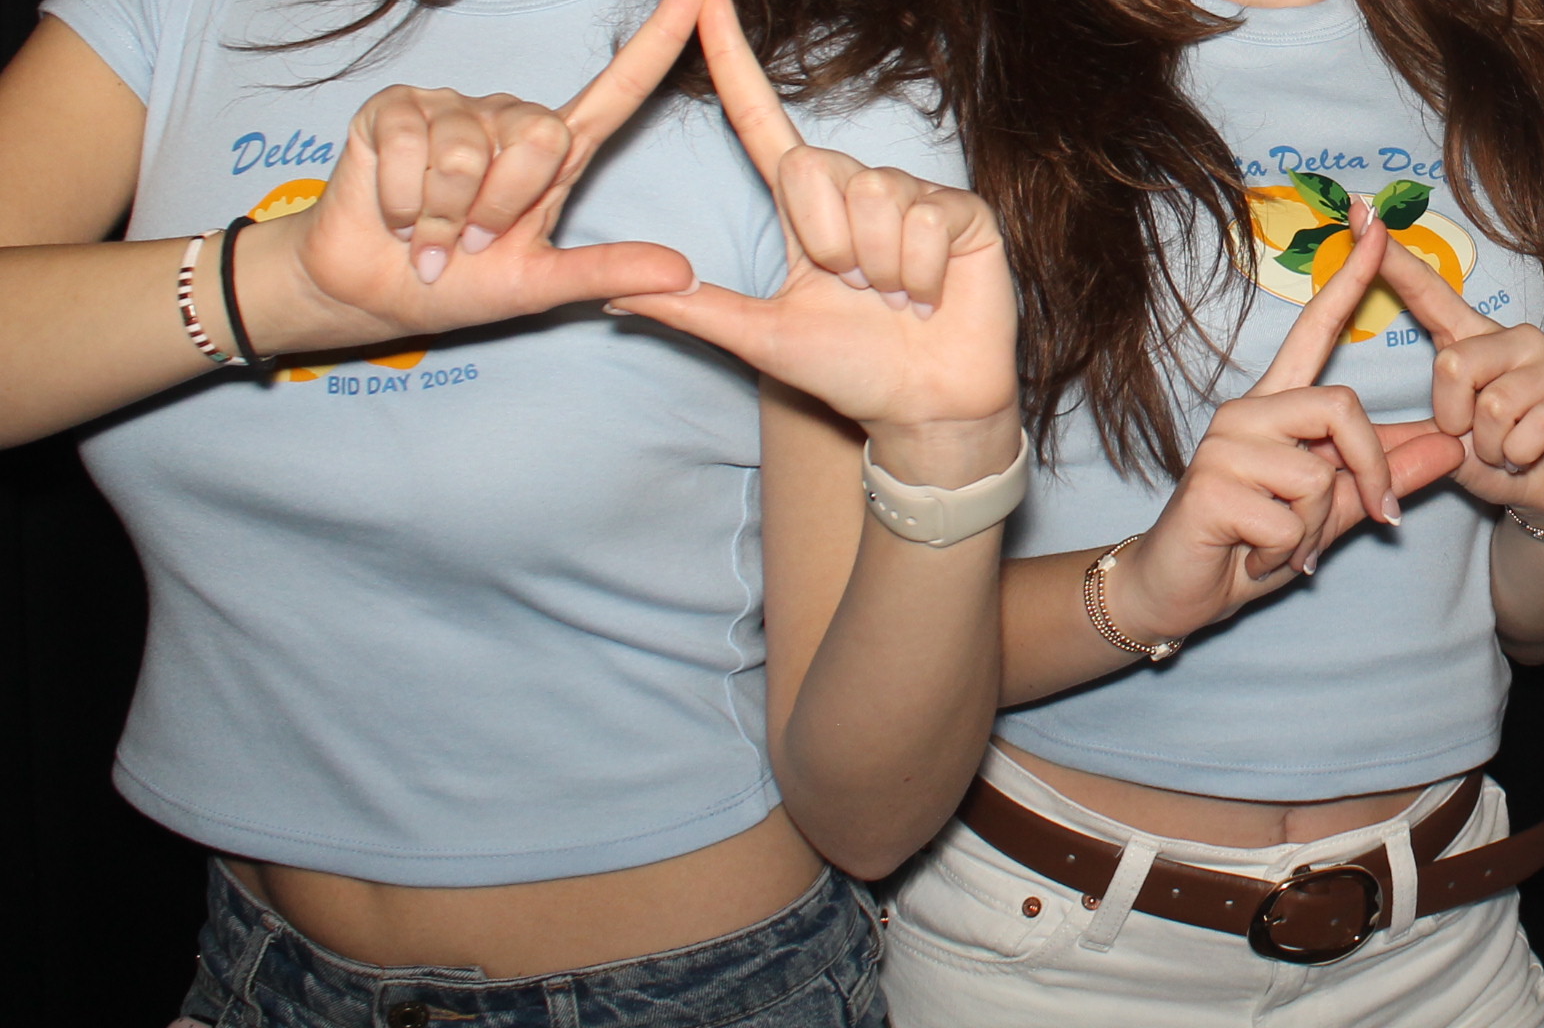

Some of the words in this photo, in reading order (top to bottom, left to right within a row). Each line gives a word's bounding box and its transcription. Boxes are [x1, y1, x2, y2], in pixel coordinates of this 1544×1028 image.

[231, 129, 334, 175] Delta
[1269, 145, 1369, 175] Delta
[1377, 147, 1475, 192] Del
[1386, 328, 1420, 348] BID
[1472, 289, 1511, 316] 026
[327, 375, 360, 396] BID
[367, 374, 412, 396] DAY
[420, 363, 479, 390] 2026
